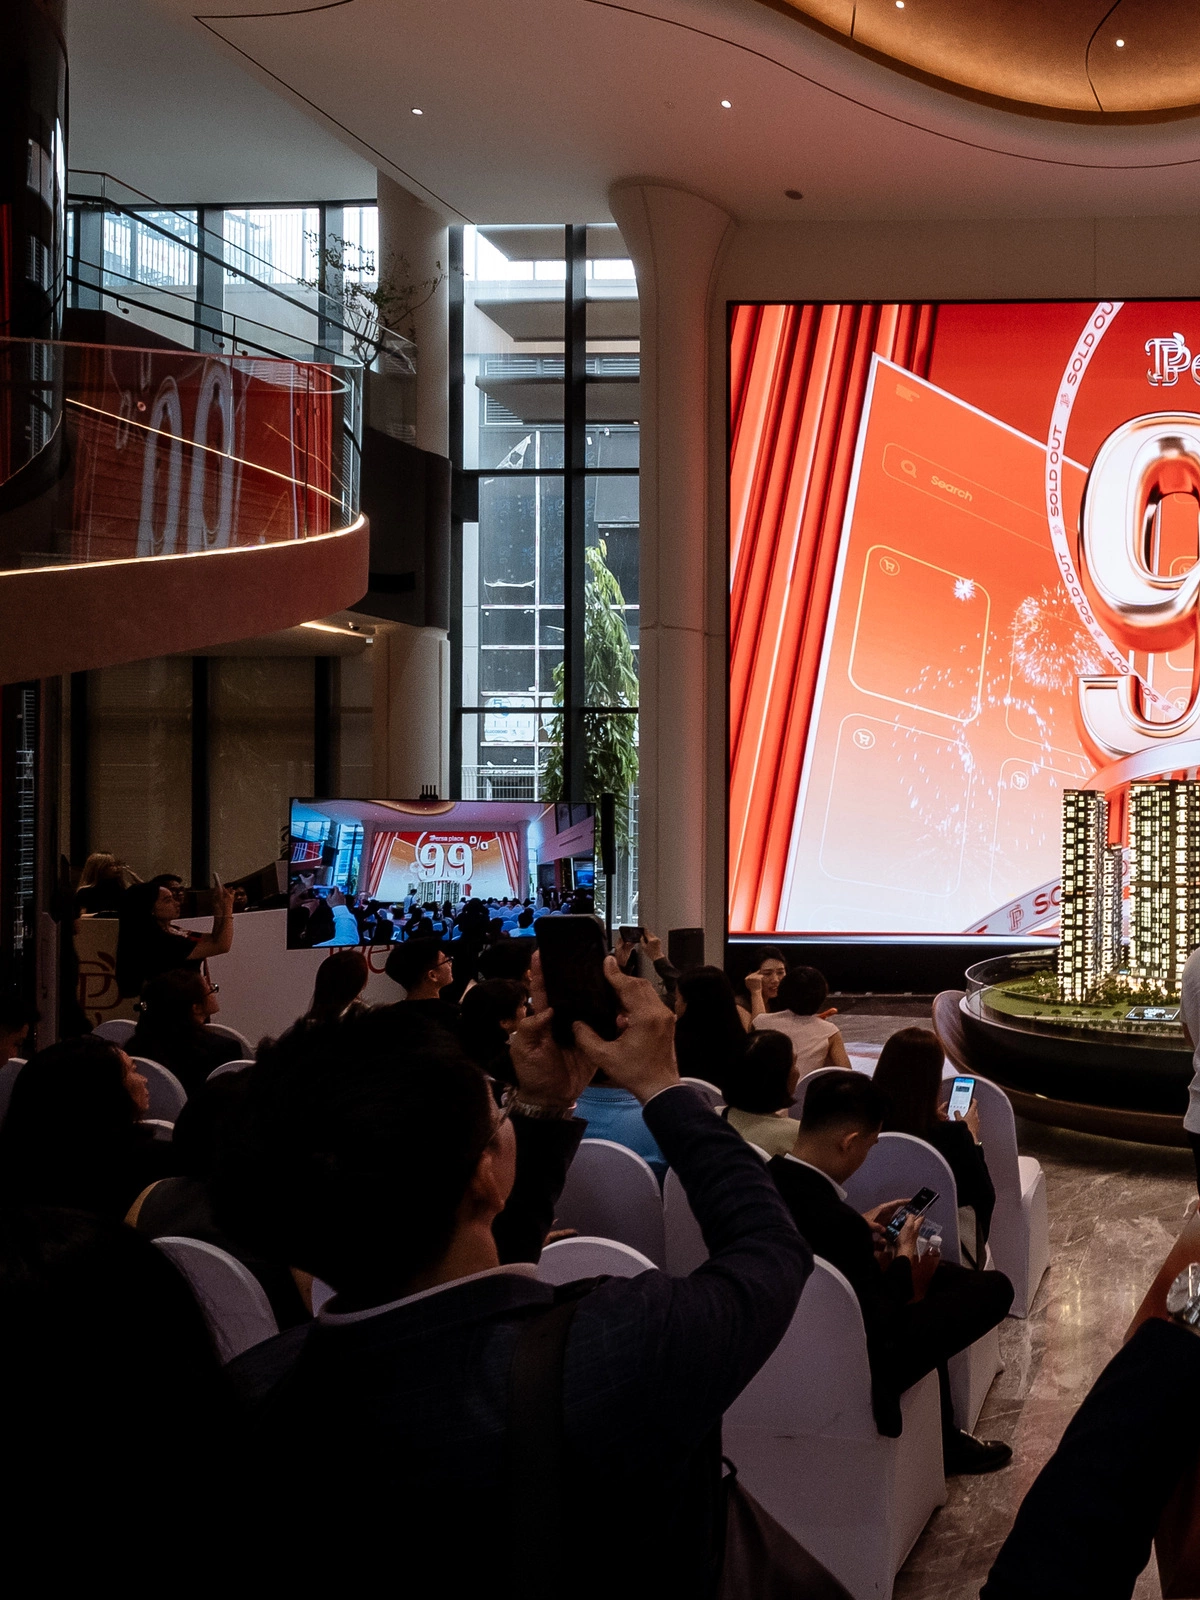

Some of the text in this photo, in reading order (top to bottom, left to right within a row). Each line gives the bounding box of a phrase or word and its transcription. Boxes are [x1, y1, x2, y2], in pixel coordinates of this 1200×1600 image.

[1067, 302, 1114, 386] SOLD OU
[1050, 424, 1062, 464] OUT
[1049, 469, 1059, 517] SOLD
[1059, 552, 1094, 625] SOLD OUT
[1107, 650, 1130, 674] OUT
